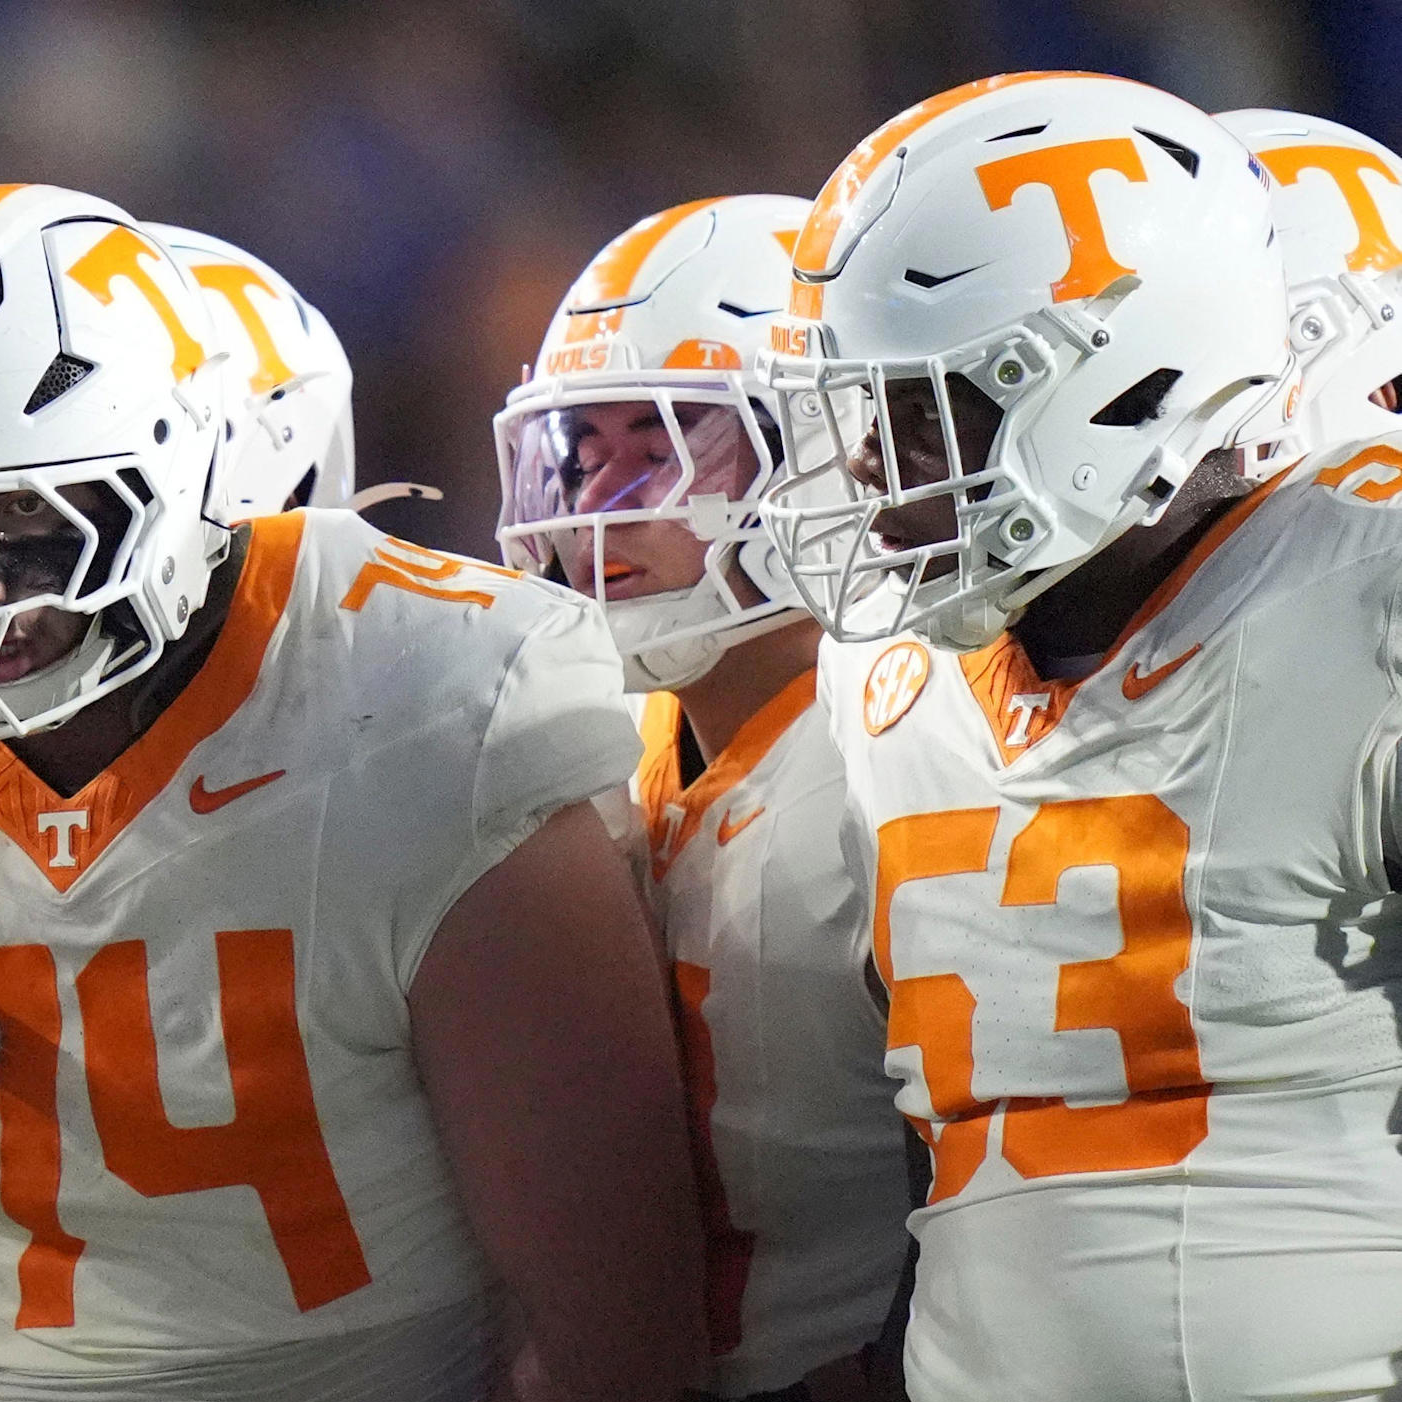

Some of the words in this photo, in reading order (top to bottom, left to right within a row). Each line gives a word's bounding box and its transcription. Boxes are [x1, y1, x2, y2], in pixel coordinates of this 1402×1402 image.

[975, 137, 1148, 304] T
[65, 224, 206, 383] T
[546, 343, 609, 375] VOLS
[699, 343, 722, 367] T
[1005, 691, 1051, 746] T
[37, 809, 88, 868] T
[874, 794, 1213, 1206] 53
